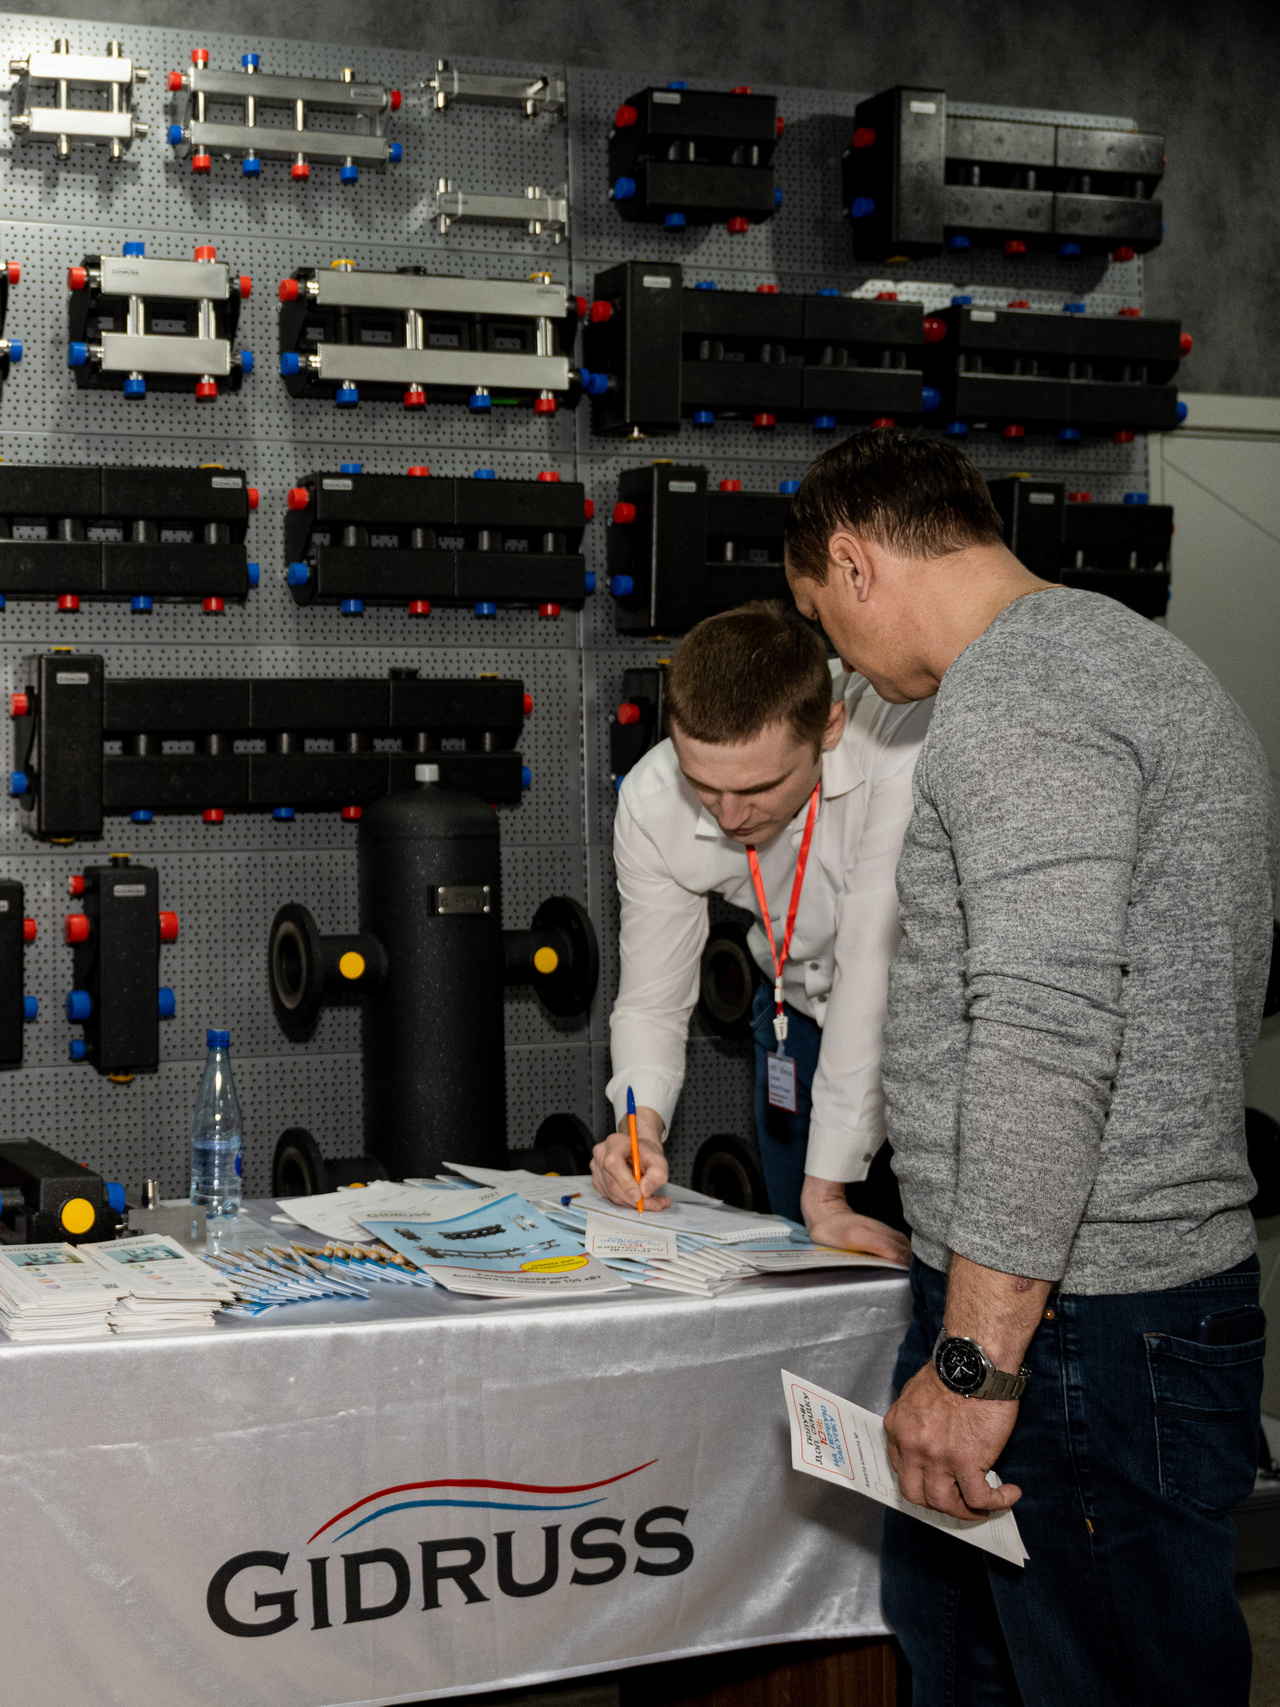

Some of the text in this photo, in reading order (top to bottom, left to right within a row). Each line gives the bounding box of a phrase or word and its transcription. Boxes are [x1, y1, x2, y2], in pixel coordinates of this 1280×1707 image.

[367, 1210, 432, 1218] GIDRUSS
[98, 1238, 155, 1249] GIDRUSS
[799, 1403, 814, 1446] ПОЛУЧИ
[803, 1391, 817, 1435] СКИДКУ
[816, 1418, 828, 1446] 10%
[821, 1404, 841, 1468] НА ПЕРВУЮ
[829, 1414, 846, 1465] ЗАКУПКУ
[206, 1505, 695, 1638] GIDRUSS
